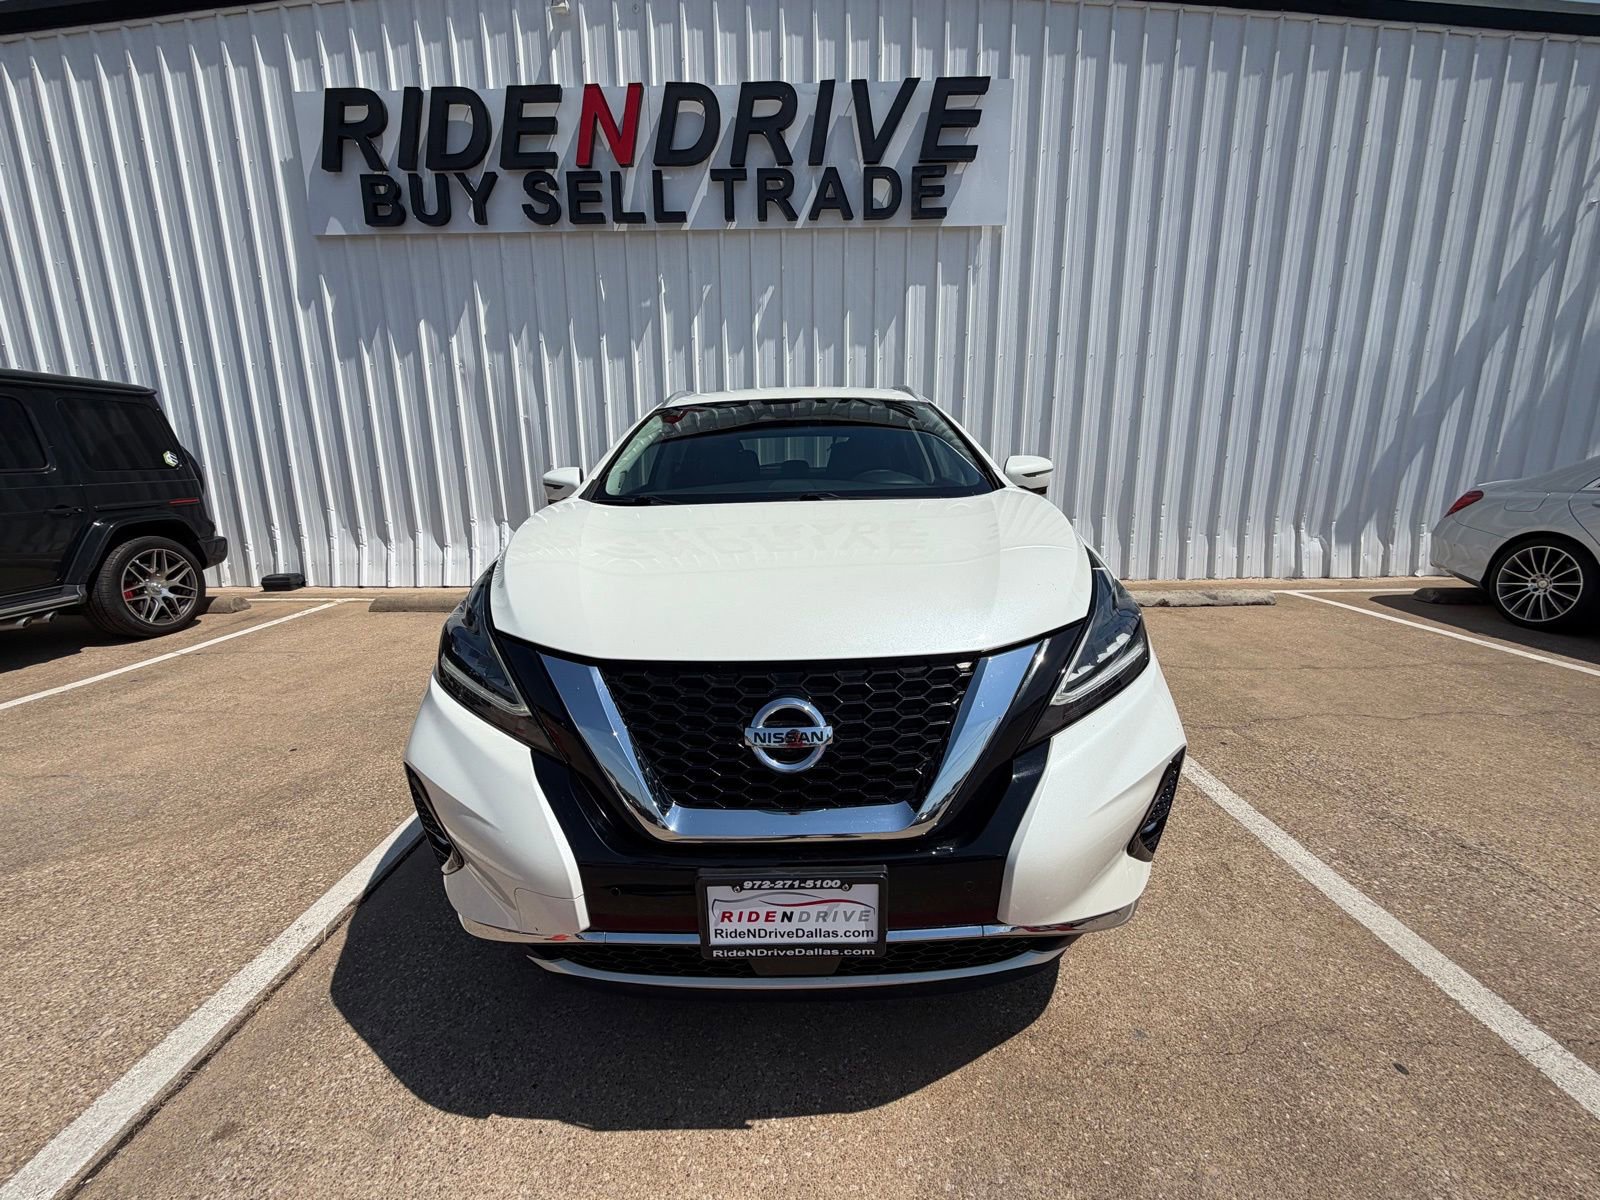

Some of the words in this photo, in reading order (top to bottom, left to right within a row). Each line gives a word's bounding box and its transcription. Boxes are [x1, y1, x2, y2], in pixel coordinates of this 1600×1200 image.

[321, 76, 991, 172] RIDENDRIVE
[360, 171, 498, 227] BUY
[522, 168, 688, 224] SELL
[710, 165, 949, 222] TRADE
[753, 730, 824, 744] NISSAN
[743, 879, 841, 889] 972-271-5100
[720, 910, 871, 922] RIDENDRIVE
[714, 928, 874, 939] RideNDriveDallas.com
[713, 948, 875, 957] RideNDriveDallas.com
